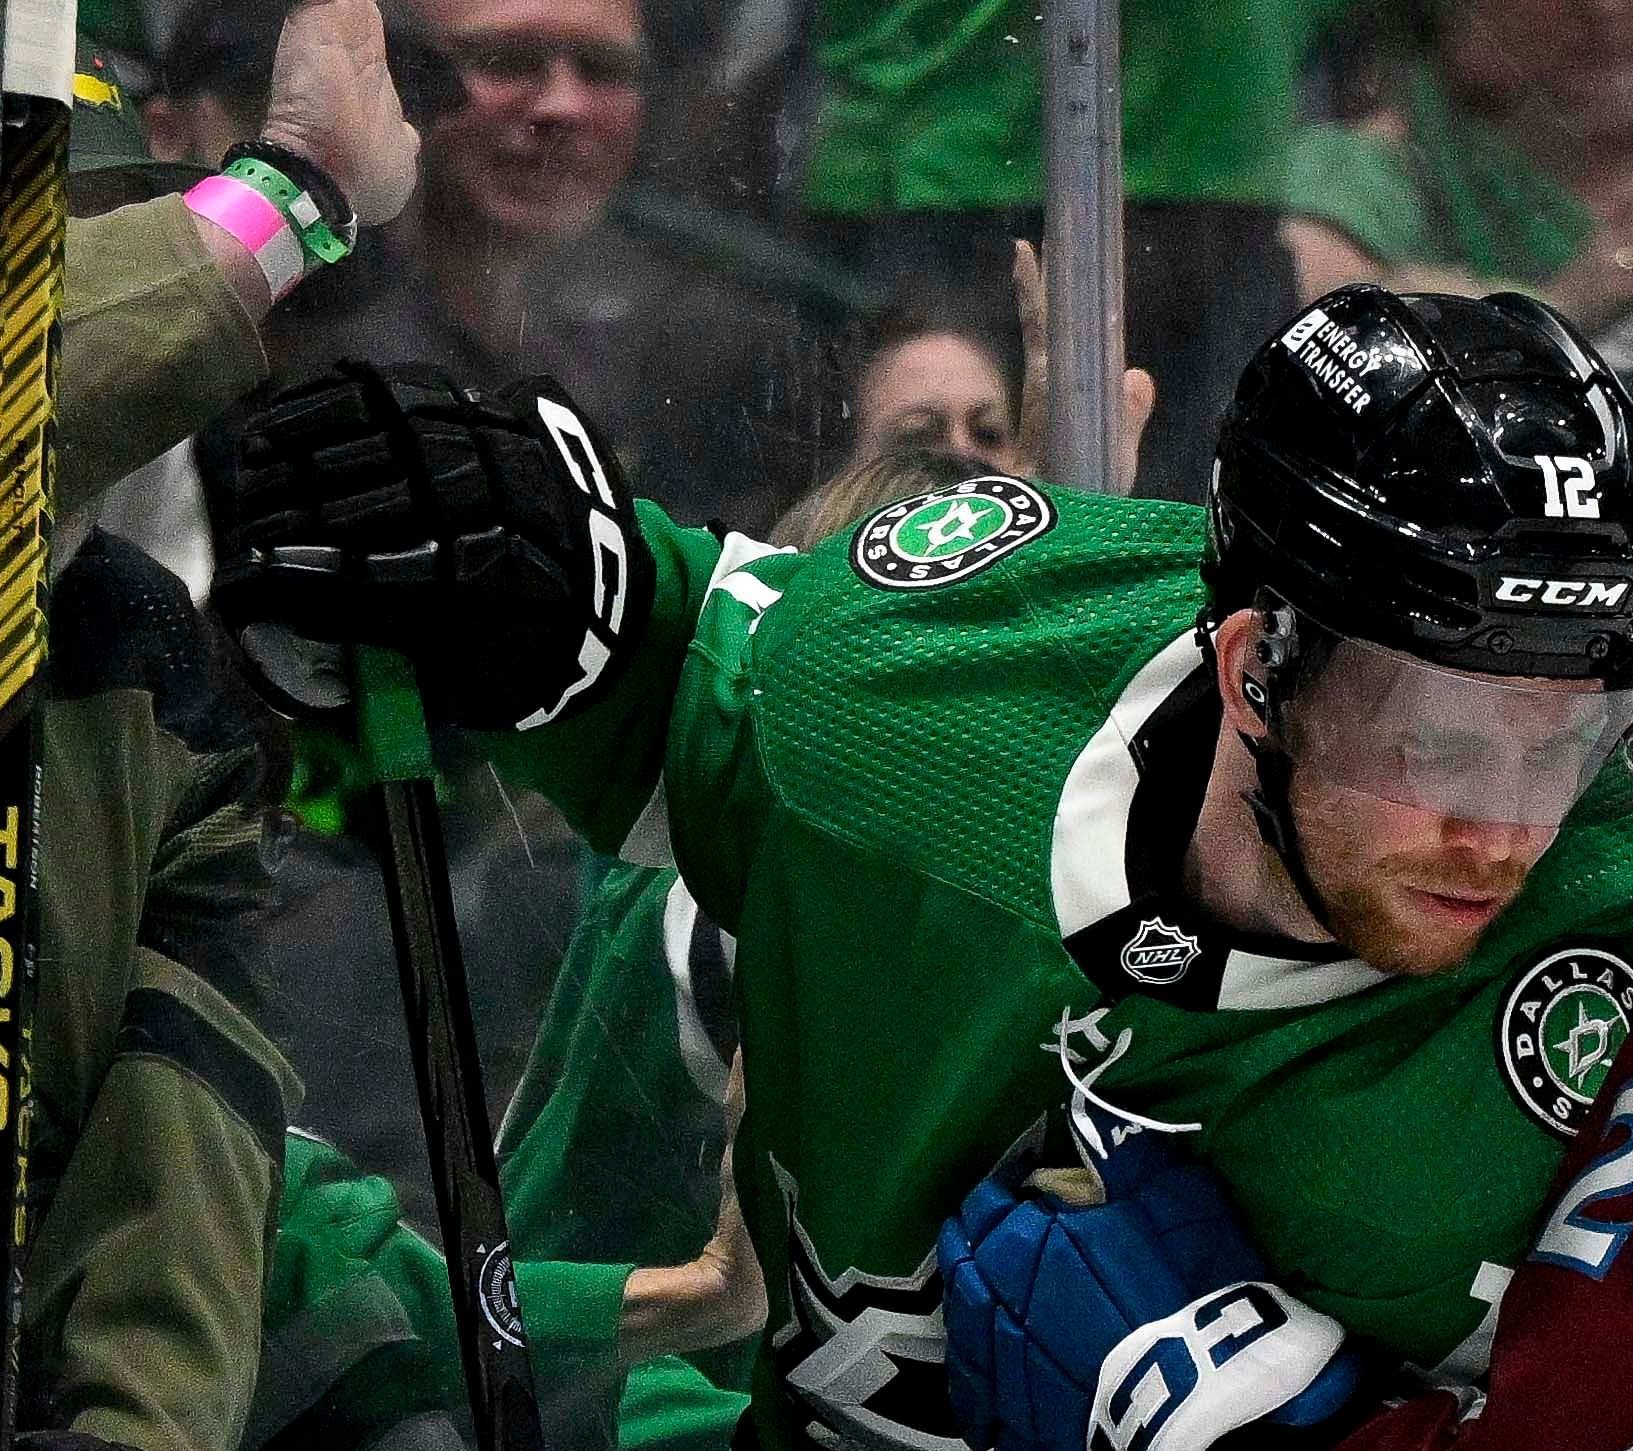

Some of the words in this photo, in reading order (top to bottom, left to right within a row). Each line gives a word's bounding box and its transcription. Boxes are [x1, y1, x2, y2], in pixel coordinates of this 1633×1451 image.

[1299, 340, 1371, 414] TRANSFER
[1316, 321, 1382, 377] ENERGY
[1534, 455, 1600, 519] 12
[909, 493, 1037, 580] DALLAS
[1495, 577, 1629, 607] CCM
[1134, 949, 1184, 966] NHL
